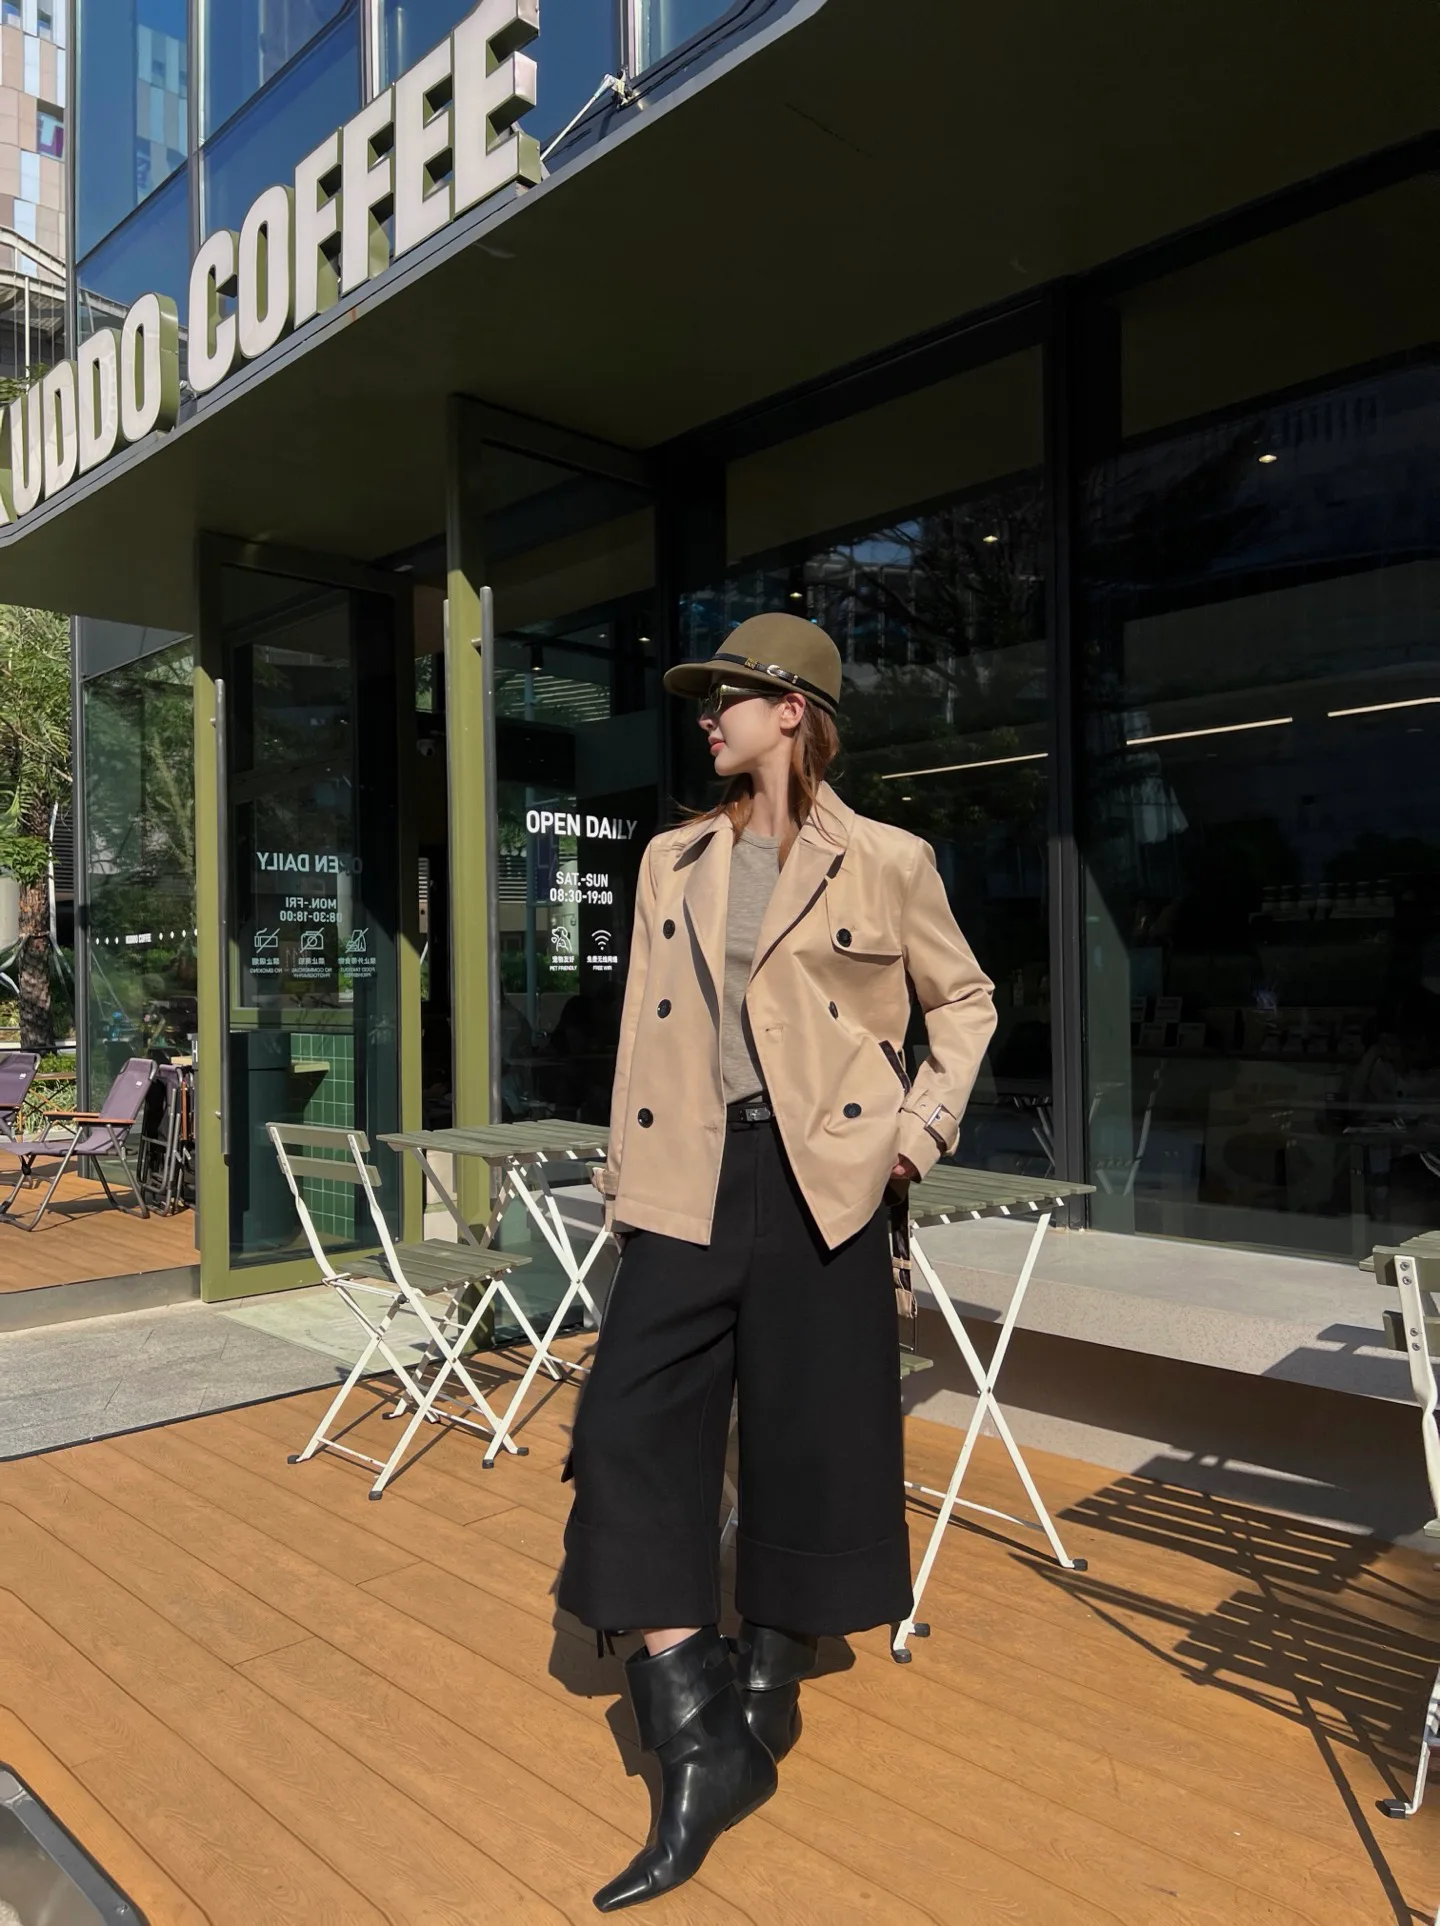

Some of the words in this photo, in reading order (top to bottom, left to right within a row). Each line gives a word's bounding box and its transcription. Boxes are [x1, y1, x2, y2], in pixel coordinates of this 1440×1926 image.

[187, 0, 538, 394] COFFEE
[526, 810, 581, 837] OPEN
[586, 815, 638, 840] DAILY
[556, 871, 609, 888] SAT.-SUN
[550, 888, 613, 904] 08:30-19:00
